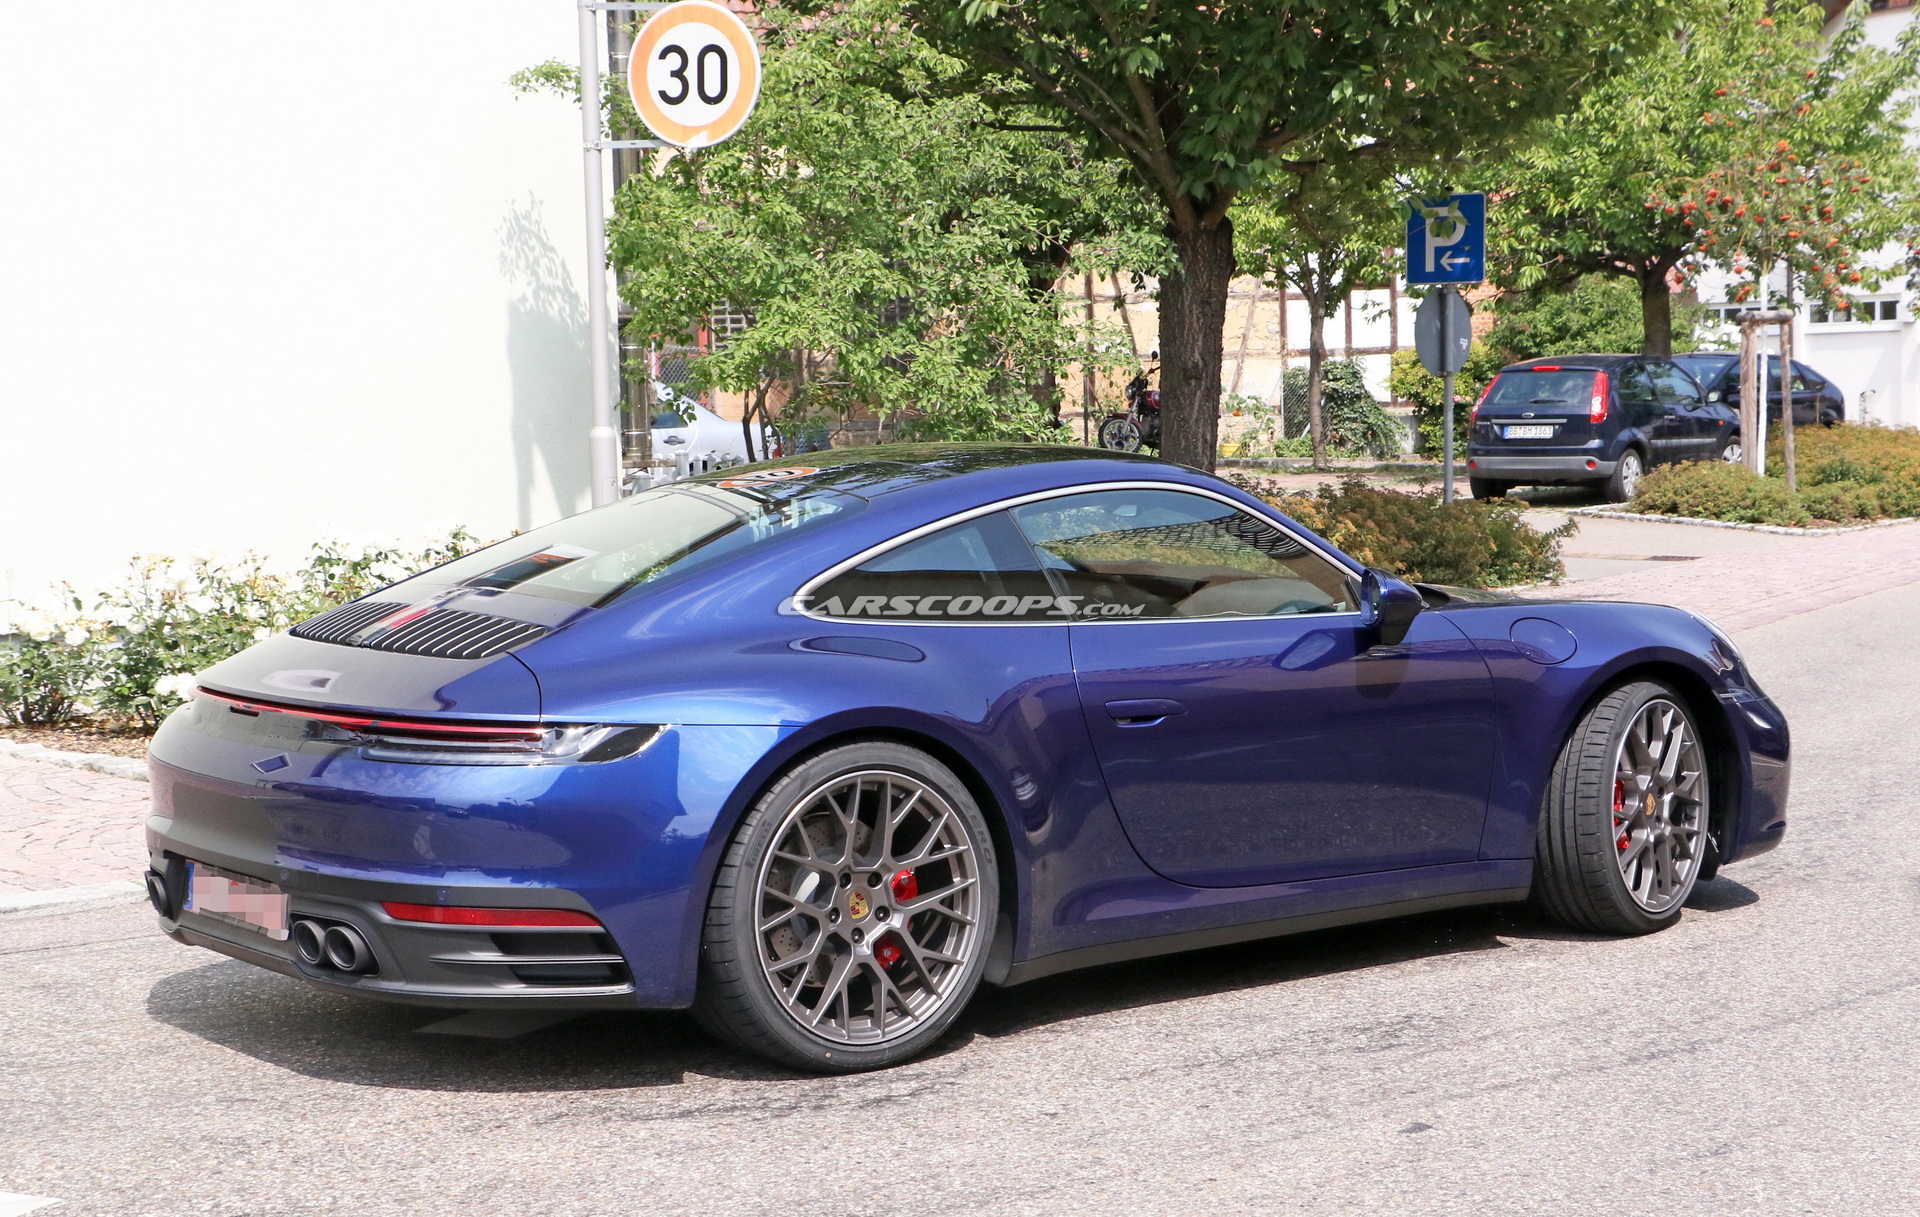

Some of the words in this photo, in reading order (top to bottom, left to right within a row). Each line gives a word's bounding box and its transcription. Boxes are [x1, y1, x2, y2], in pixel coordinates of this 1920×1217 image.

[658, 44, 728, 105] 30
[1425, 206, 1466, 272] P
[1509, 426, 1518, 435] BB
[1534, 426, 1552, 435] 1863
